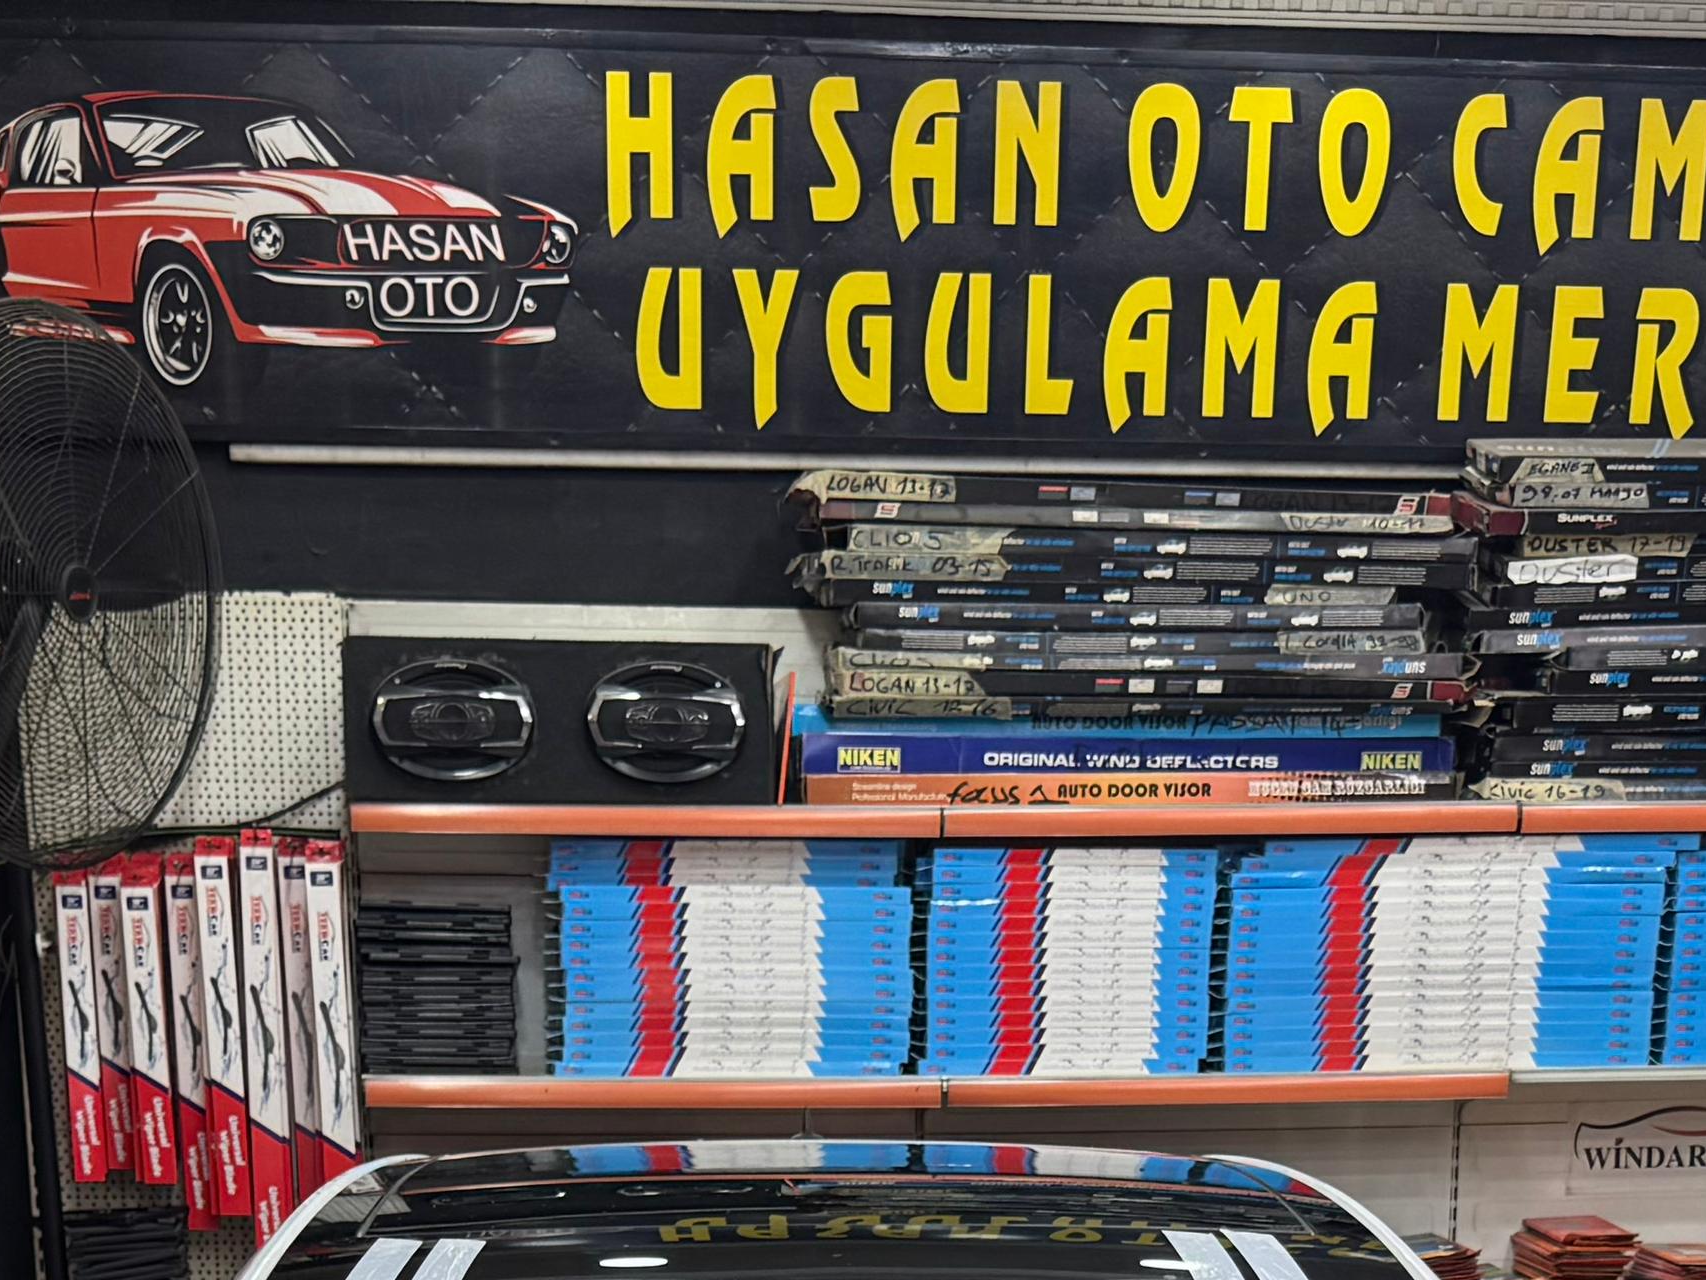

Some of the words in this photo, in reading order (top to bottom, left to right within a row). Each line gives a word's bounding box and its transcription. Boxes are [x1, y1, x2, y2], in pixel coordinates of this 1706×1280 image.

[608, 71, 1061, 241] HASAN
[1130, 84, 1390, 236] OTO
[343, 223, 506, 262] HASAN
[379, 276, 480, 318] OTO
[636, 267, 1377, 436] UYGULAMA
[828, 475, 887, 494] LOGAN
[1557, 513, 1613, 523] SUNPLEX
[1529, 535, 1615, 552] DUSTER
[1519, 558, 1622, 583] Duster
[1283, 591, 1332, 603] UNO
[1509, 611, 1556, 626] sunplex
[1516, 632, 1563, 647] sunplex
[850, 672, 915, 693] LOGAN
[839, 750, 899, 767] NIKEN
[984, 752, 1077, 767] ORIGINAL
[1362, 753, 1421, 770] NIKEN
[1057, 783, 1102, 798] AUTO
[1108, 783, 1159, 798] DOOR
[1164, 783, 1212, 798] VISOR
[1545, 785, 1606, 799] 16-19
[84, 1094, 101, 1146] Universal
[153, 1096, 170, 1148] Universal
[228, 1115, 246, 1166] Universal
